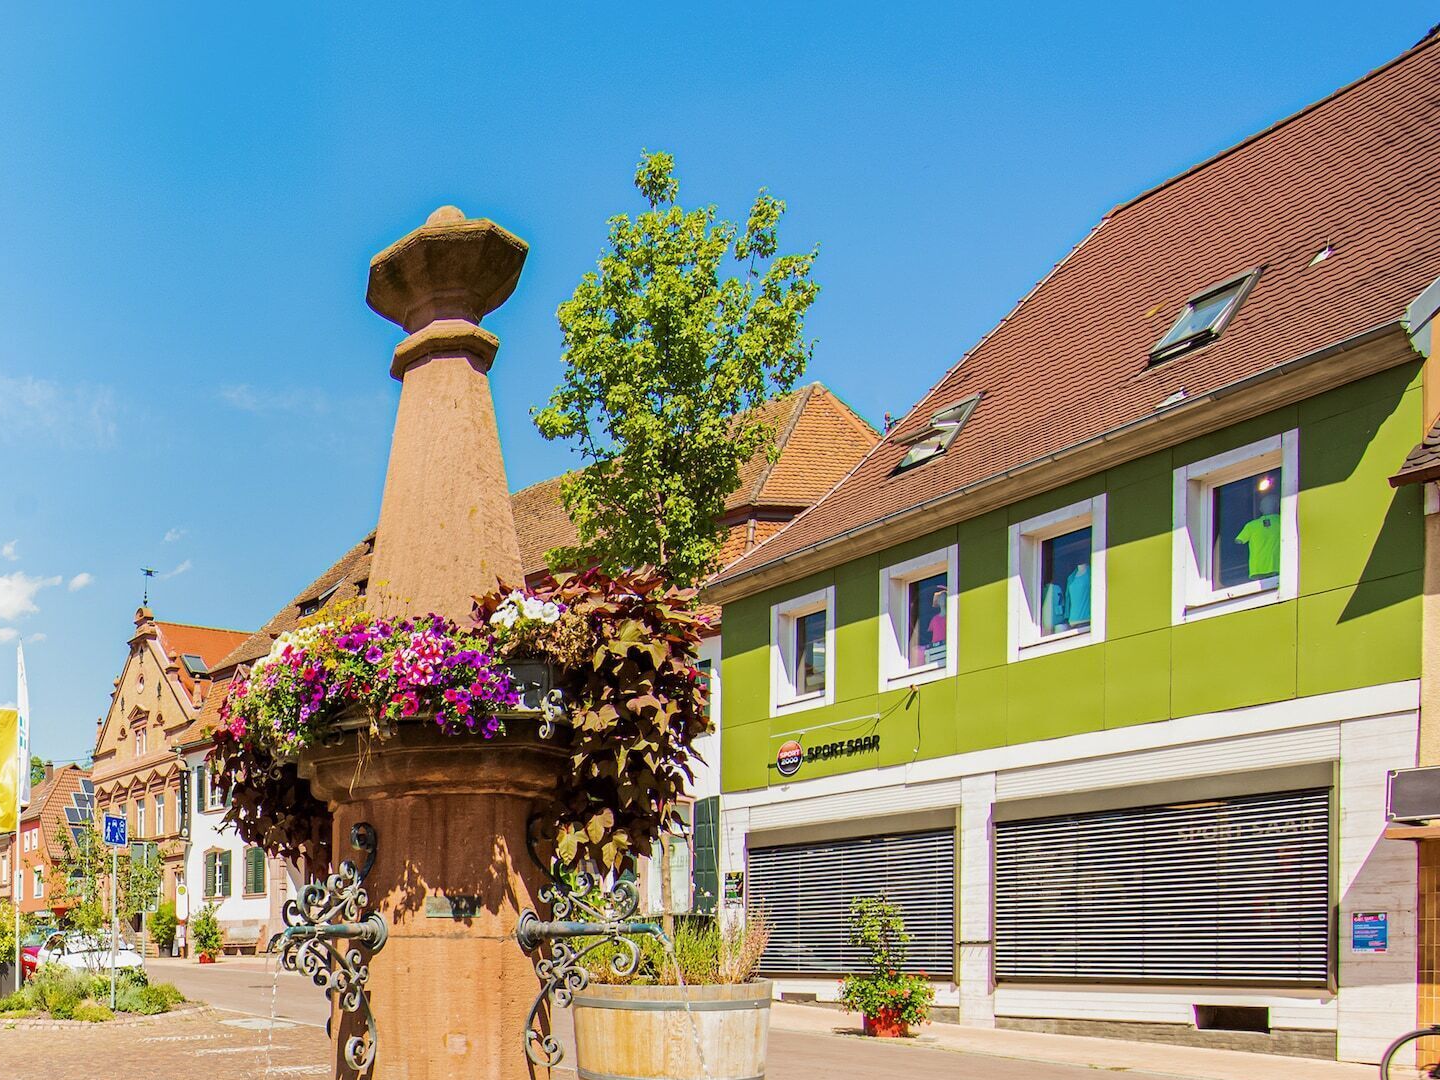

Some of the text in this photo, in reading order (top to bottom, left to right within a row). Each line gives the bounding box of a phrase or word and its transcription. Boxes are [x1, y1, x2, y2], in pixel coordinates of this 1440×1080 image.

[807, 734, 881, 761] SPORT SAAR
[779, 749, 800, 758] SPORT
[780, 756, 800, 766] 2000
